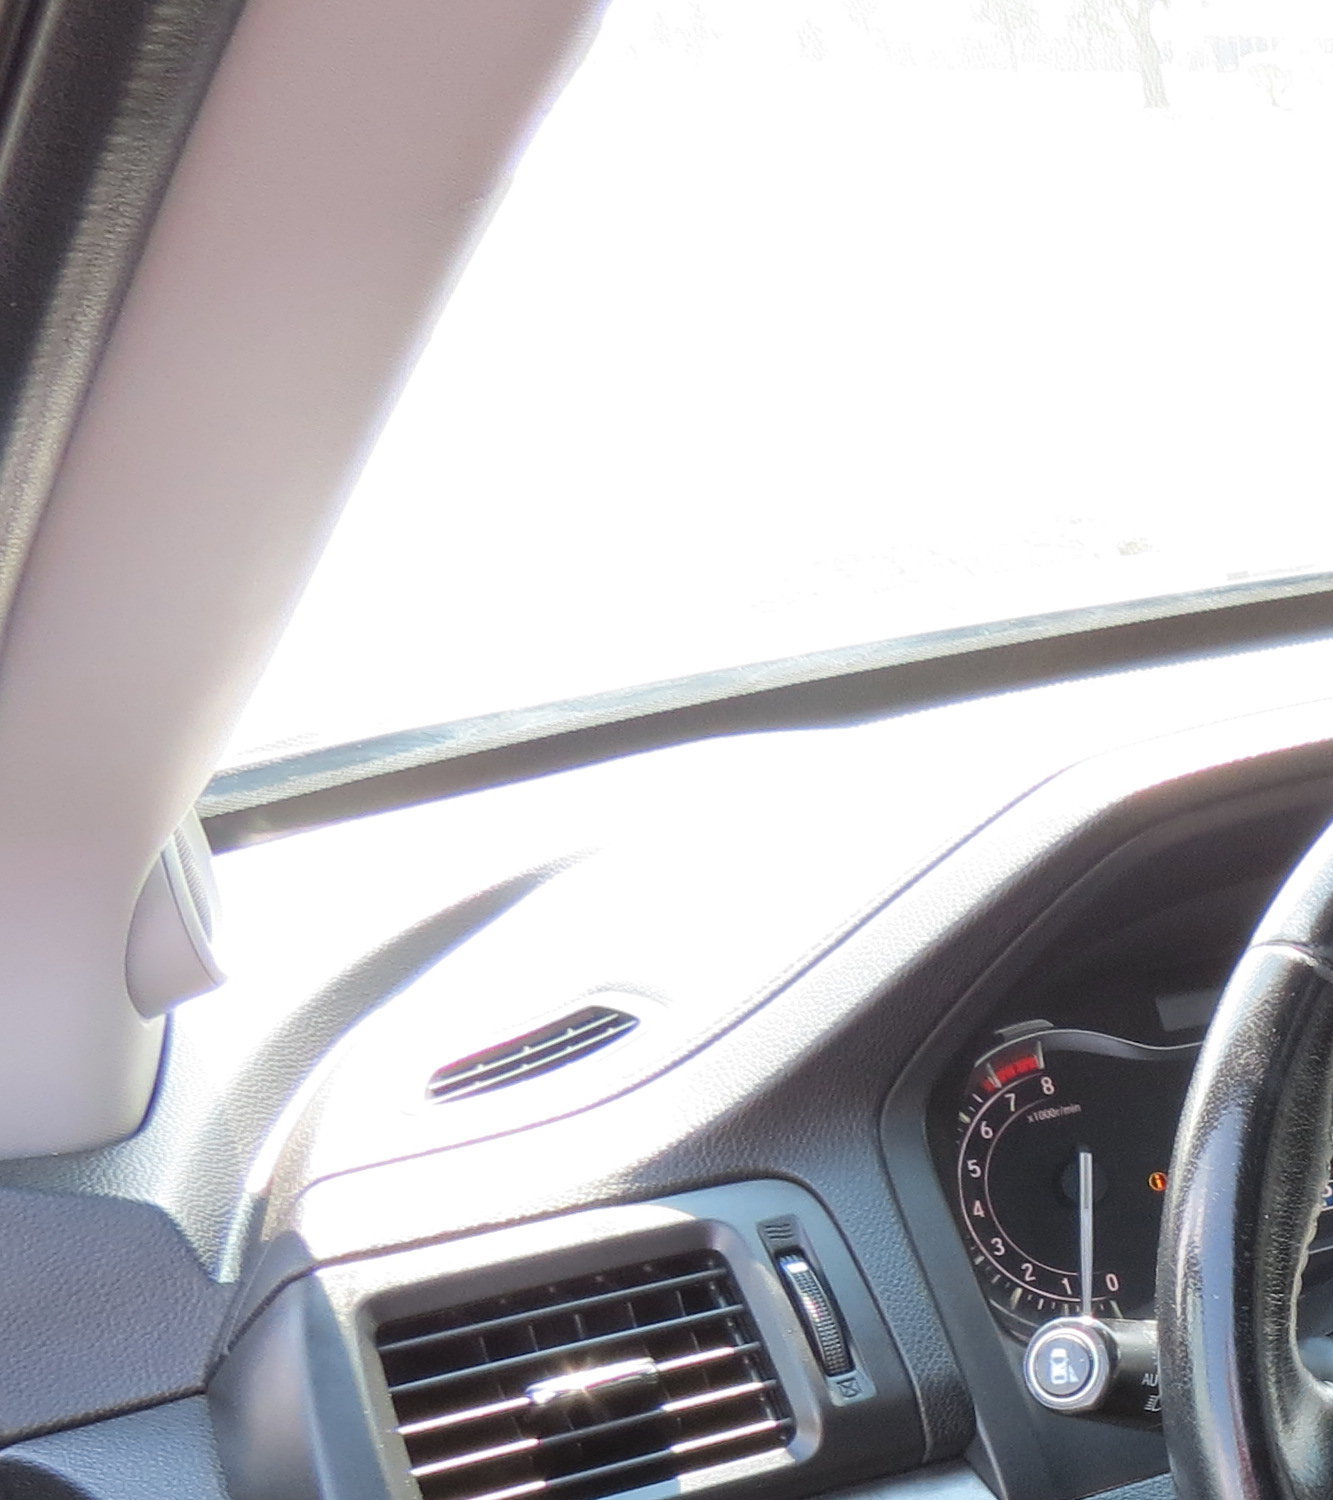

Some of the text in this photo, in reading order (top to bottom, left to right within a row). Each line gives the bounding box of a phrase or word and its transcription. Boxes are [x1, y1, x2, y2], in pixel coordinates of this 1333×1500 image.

[1040, 1075, 1055, 1095] 8
[1004, 1093, 1017, 1112] 7
[980, 1121, 993, 1140] 6
[967, 1159, 982, 1179] 5
[973, 1200, 985, 1218] 4
[990, 1237, 1006, 1256] 3
[1021, 1263, 1036, 1282] 2
[1105, 1272, 1119, 1292] 0
[1061, 1277, 1072, 1296] 1
